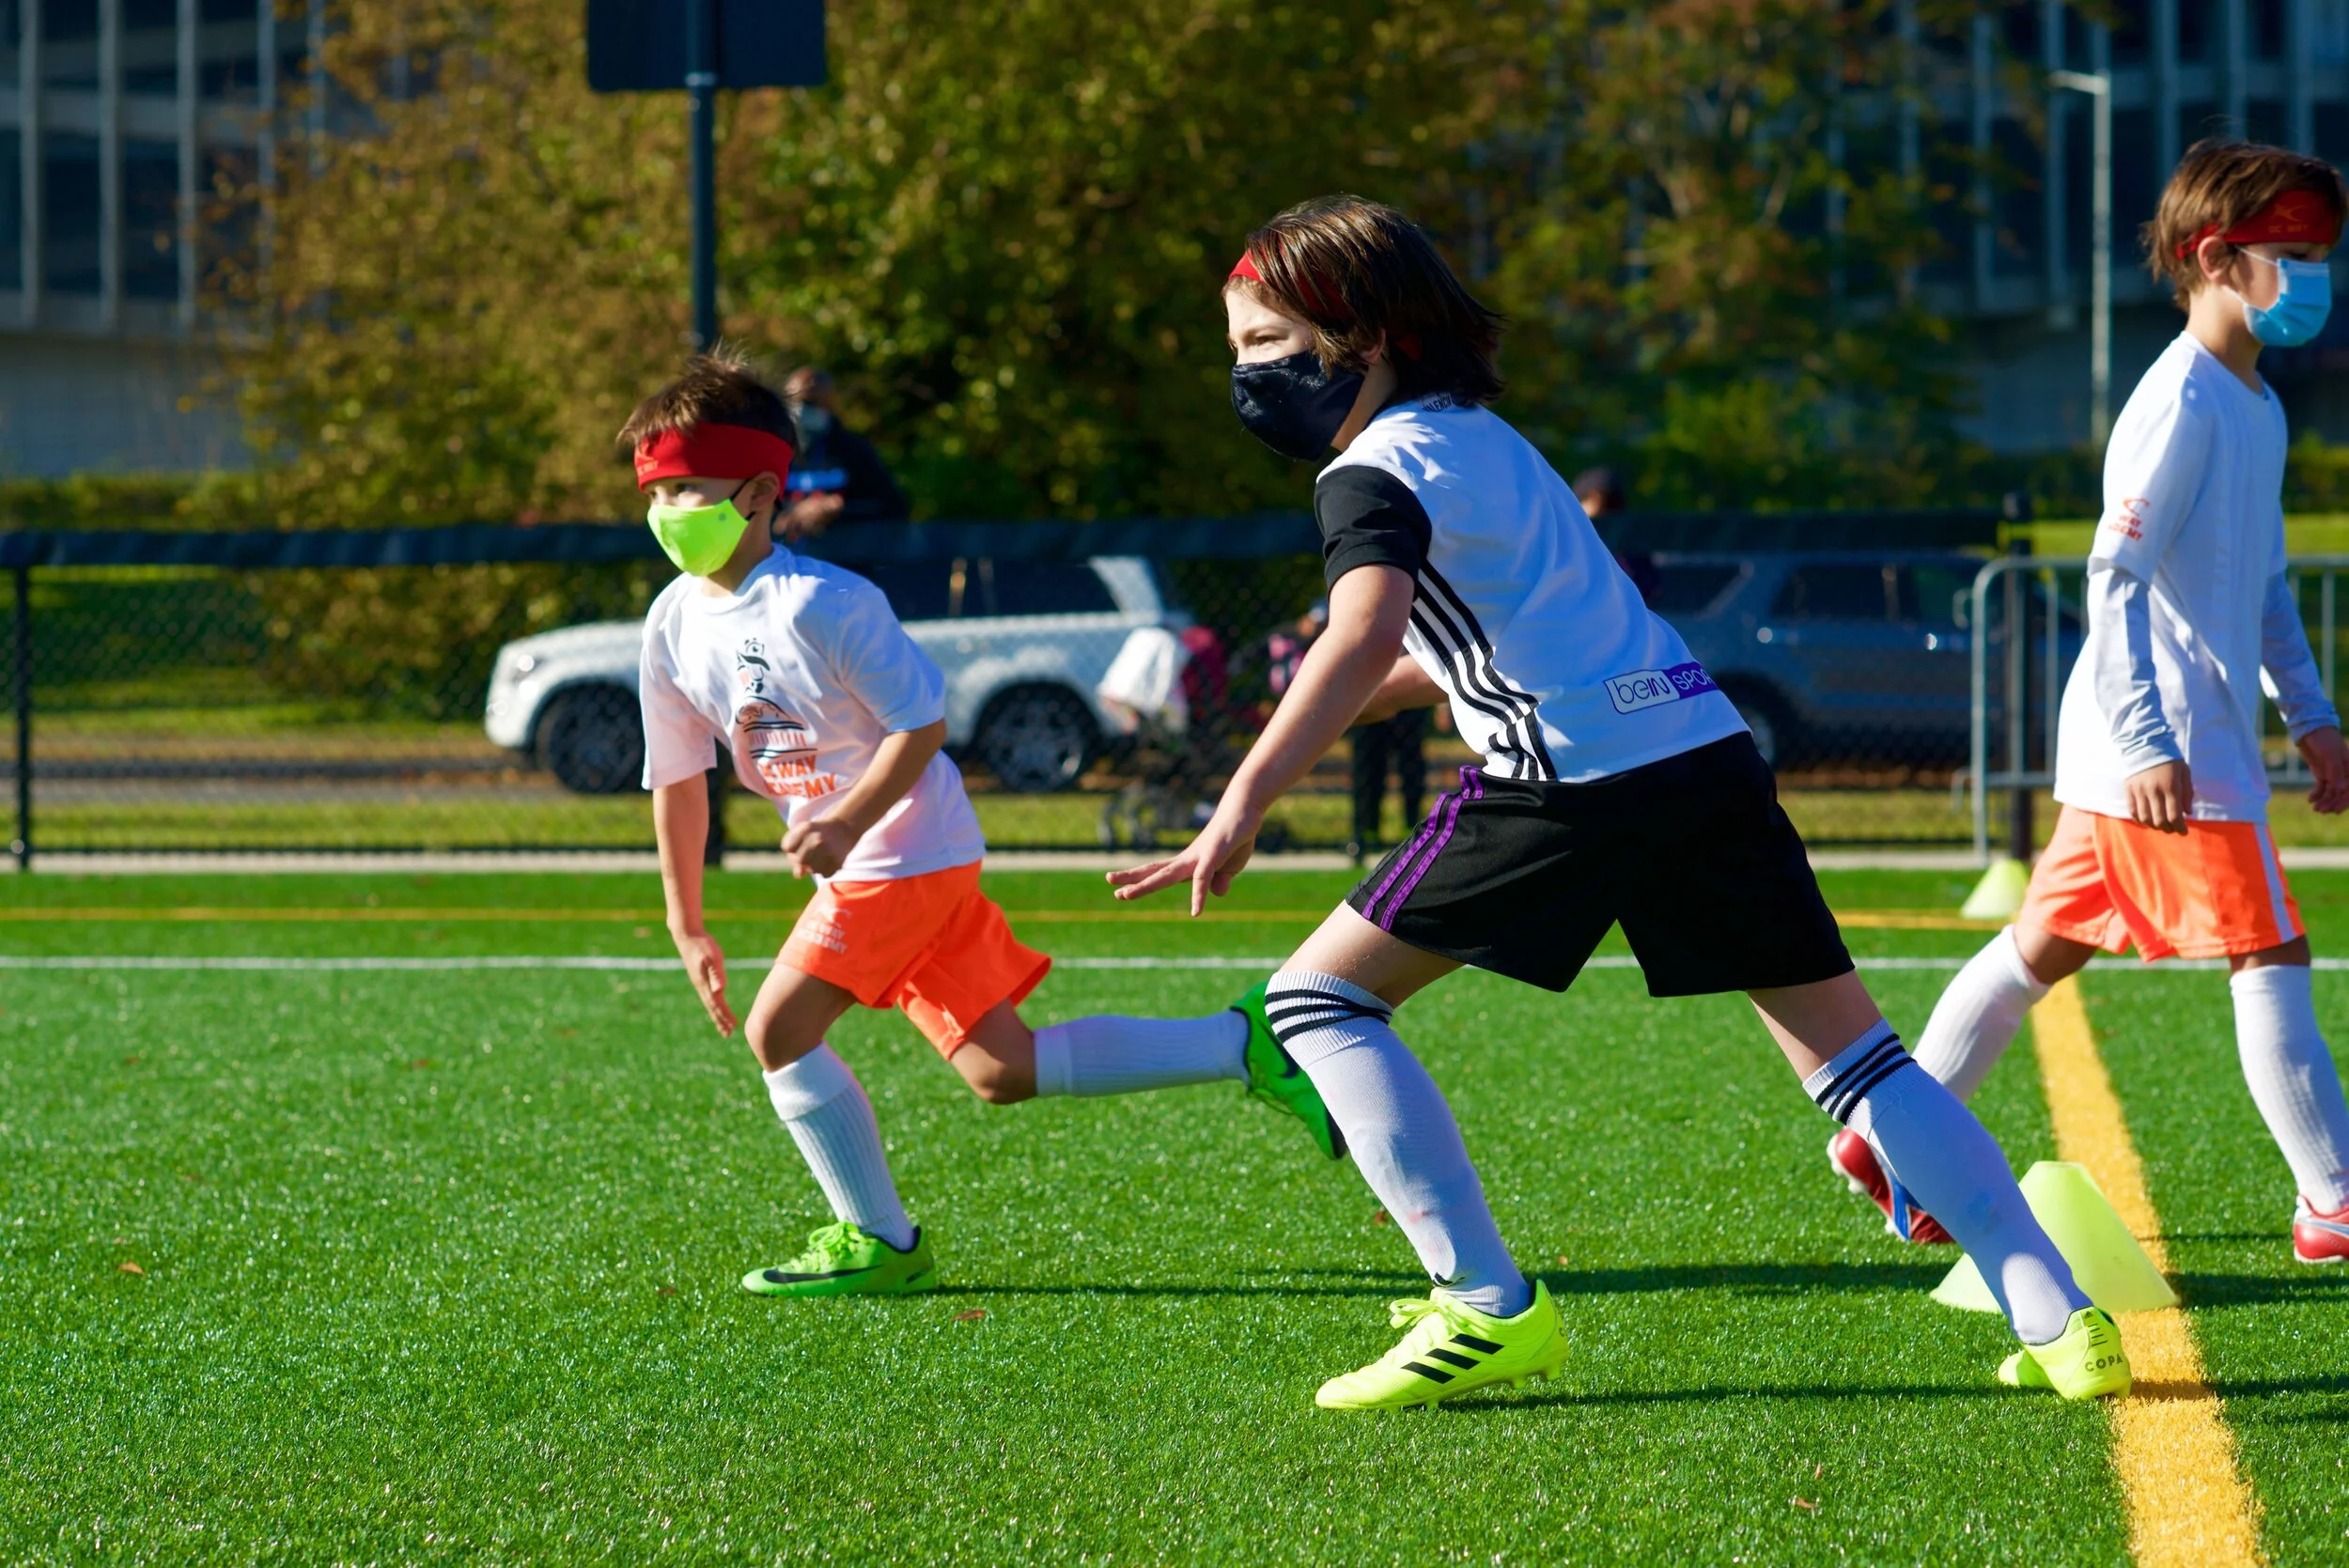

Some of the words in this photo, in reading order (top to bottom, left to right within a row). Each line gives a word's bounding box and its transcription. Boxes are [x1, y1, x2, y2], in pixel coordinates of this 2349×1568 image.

[1612, 676, 1671, 705] beIN
[775, 754, 817, 779] WAY
[2084, 1355, 2123, 1374] COPA
